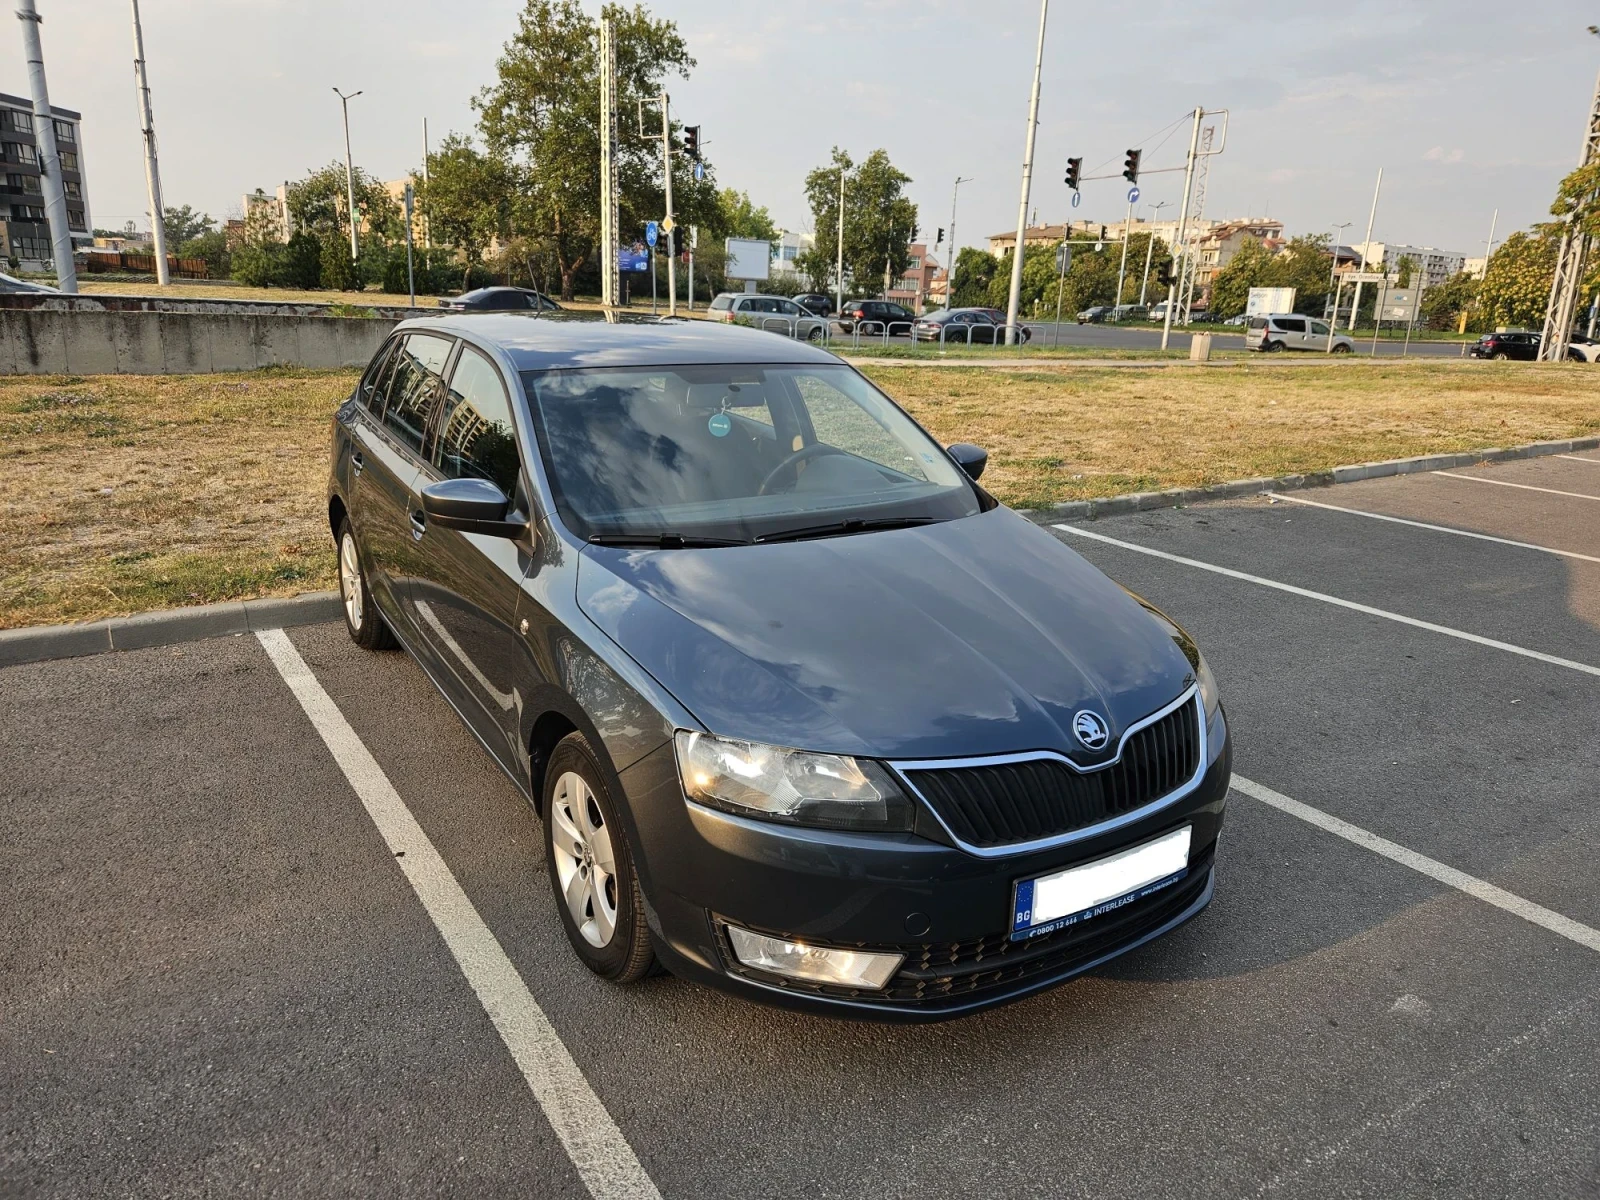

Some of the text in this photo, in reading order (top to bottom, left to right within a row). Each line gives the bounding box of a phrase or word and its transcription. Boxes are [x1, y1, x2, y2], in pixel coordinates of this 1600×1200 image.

[1016, 910, 1031, 924] BG
[1036, 925, 1055, 936] 0800
[1056, 921, 1065, 929] 12
[1094, 894, 1135, 916] INTERLEASE
